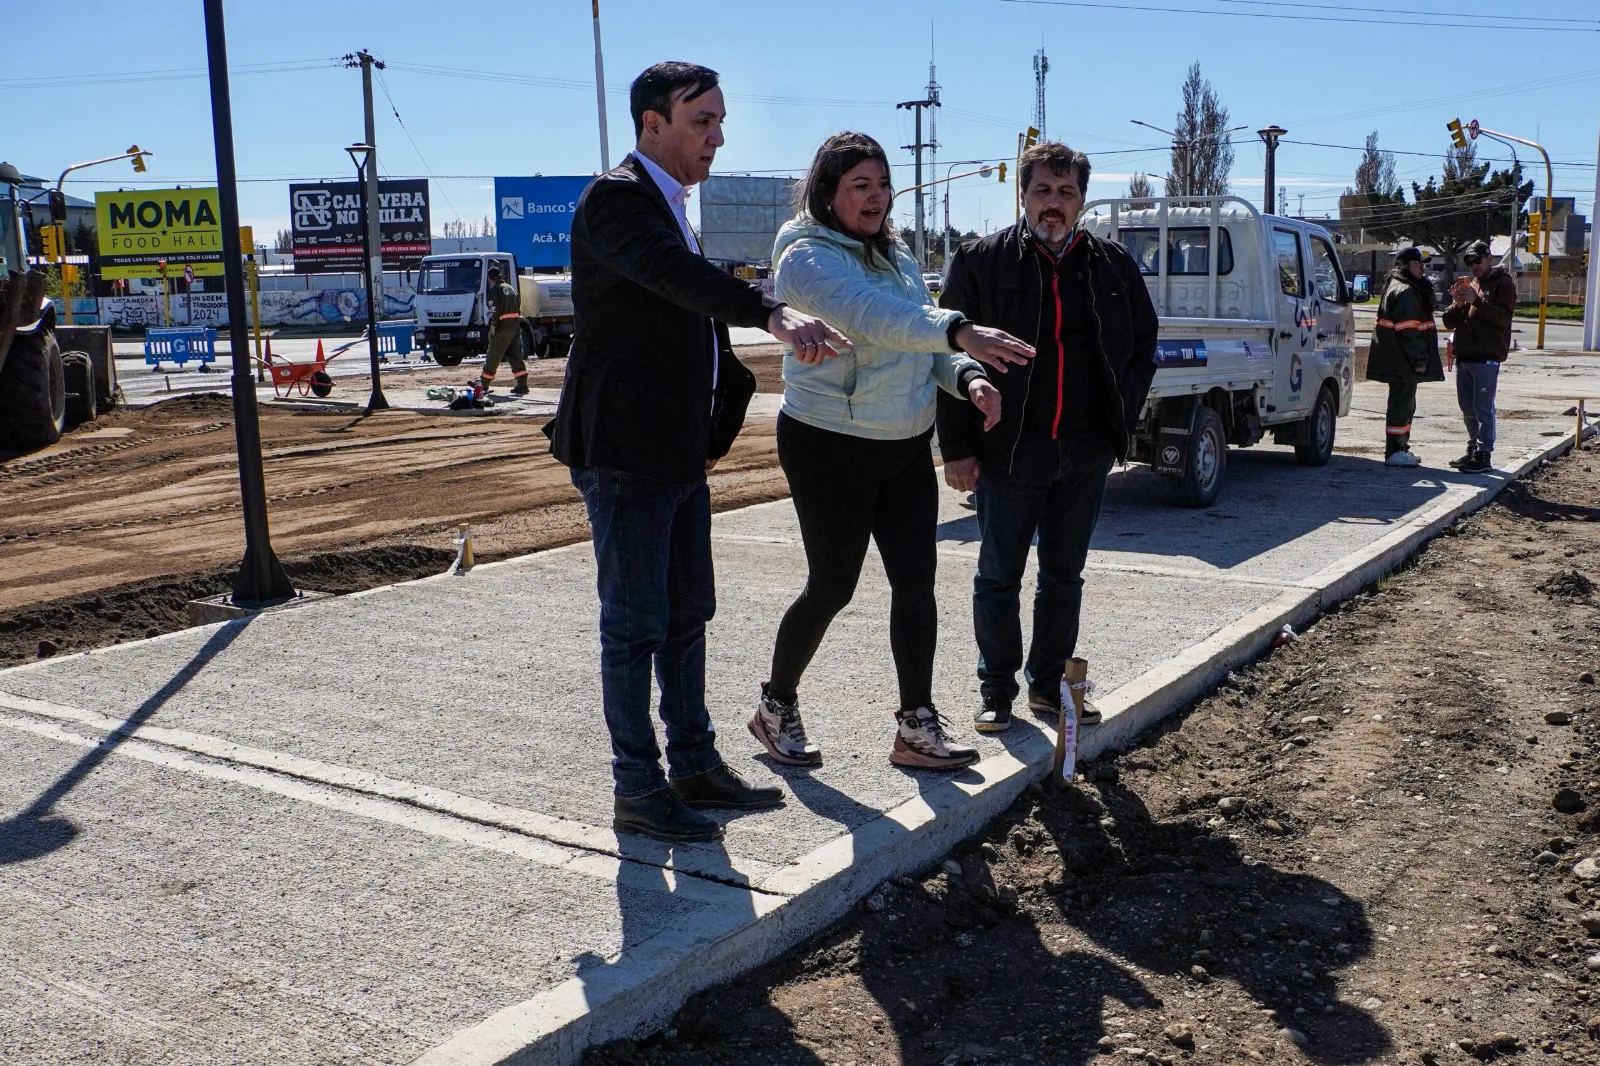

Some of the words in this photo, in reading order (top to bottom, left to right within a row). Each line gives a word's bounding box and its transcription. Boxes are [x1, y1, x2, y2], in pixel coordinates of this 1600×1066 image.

[109, 199, 218, 229] MOMA
[528, 202, 566, 214] Banco
[336, 210, 359, 225] NO
[112, 237, 161, 249] FOOD
[173, 235, 218, 247] HALL
[532, 232, 556, 243] Acá.
[558, 233, 571, 243] Pa
[194, 309, 220, 321] 2024
[173, 338, 186, 353] G
[1289, 353, 1302, 393] G
